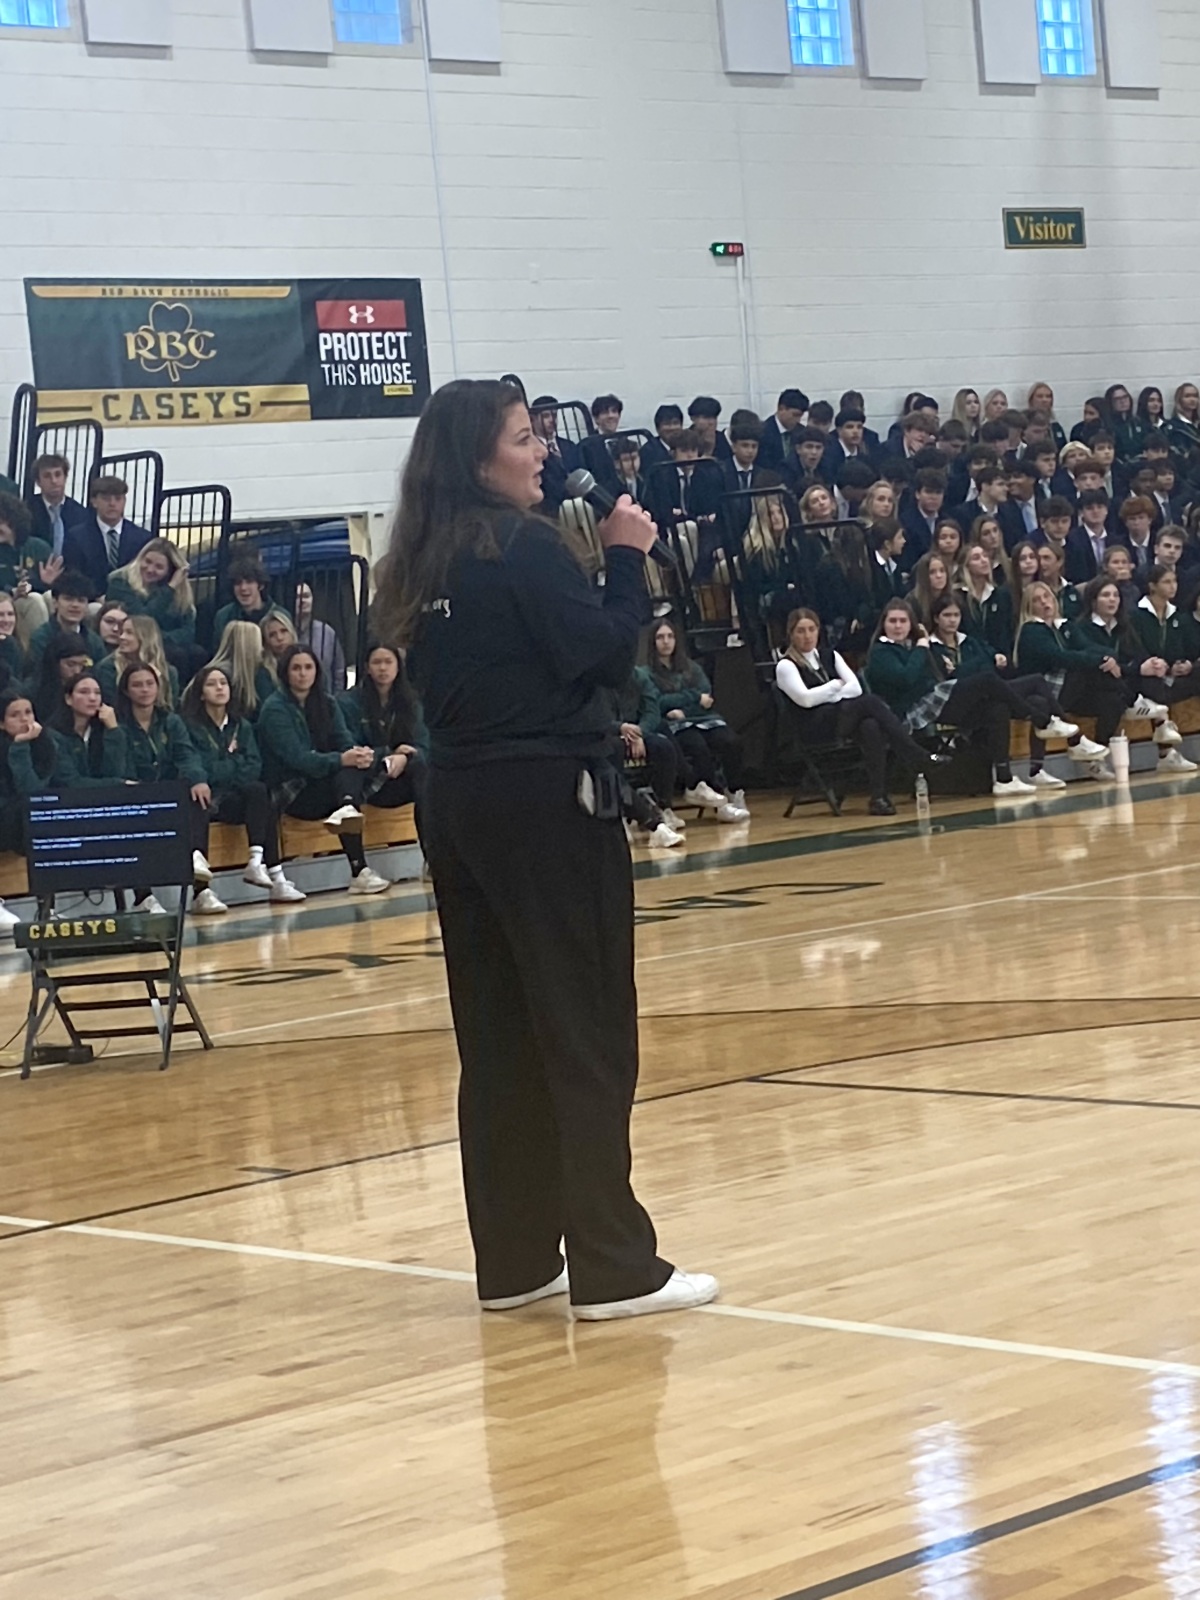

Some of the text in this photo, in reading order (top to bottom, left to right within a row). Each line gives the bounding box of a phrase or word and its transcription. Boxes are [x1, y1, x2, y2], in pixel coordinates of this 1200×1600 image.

[1013, 215, 1076, 240] Visitor
[124, 331, 217, 360] RBC
[318, 331, 408, 361] PROTECT
[320, 363, 357, 386] THIS
[102, 391, 251, 421] CASEYS
[29, 918, 116, 939] CASEYS
